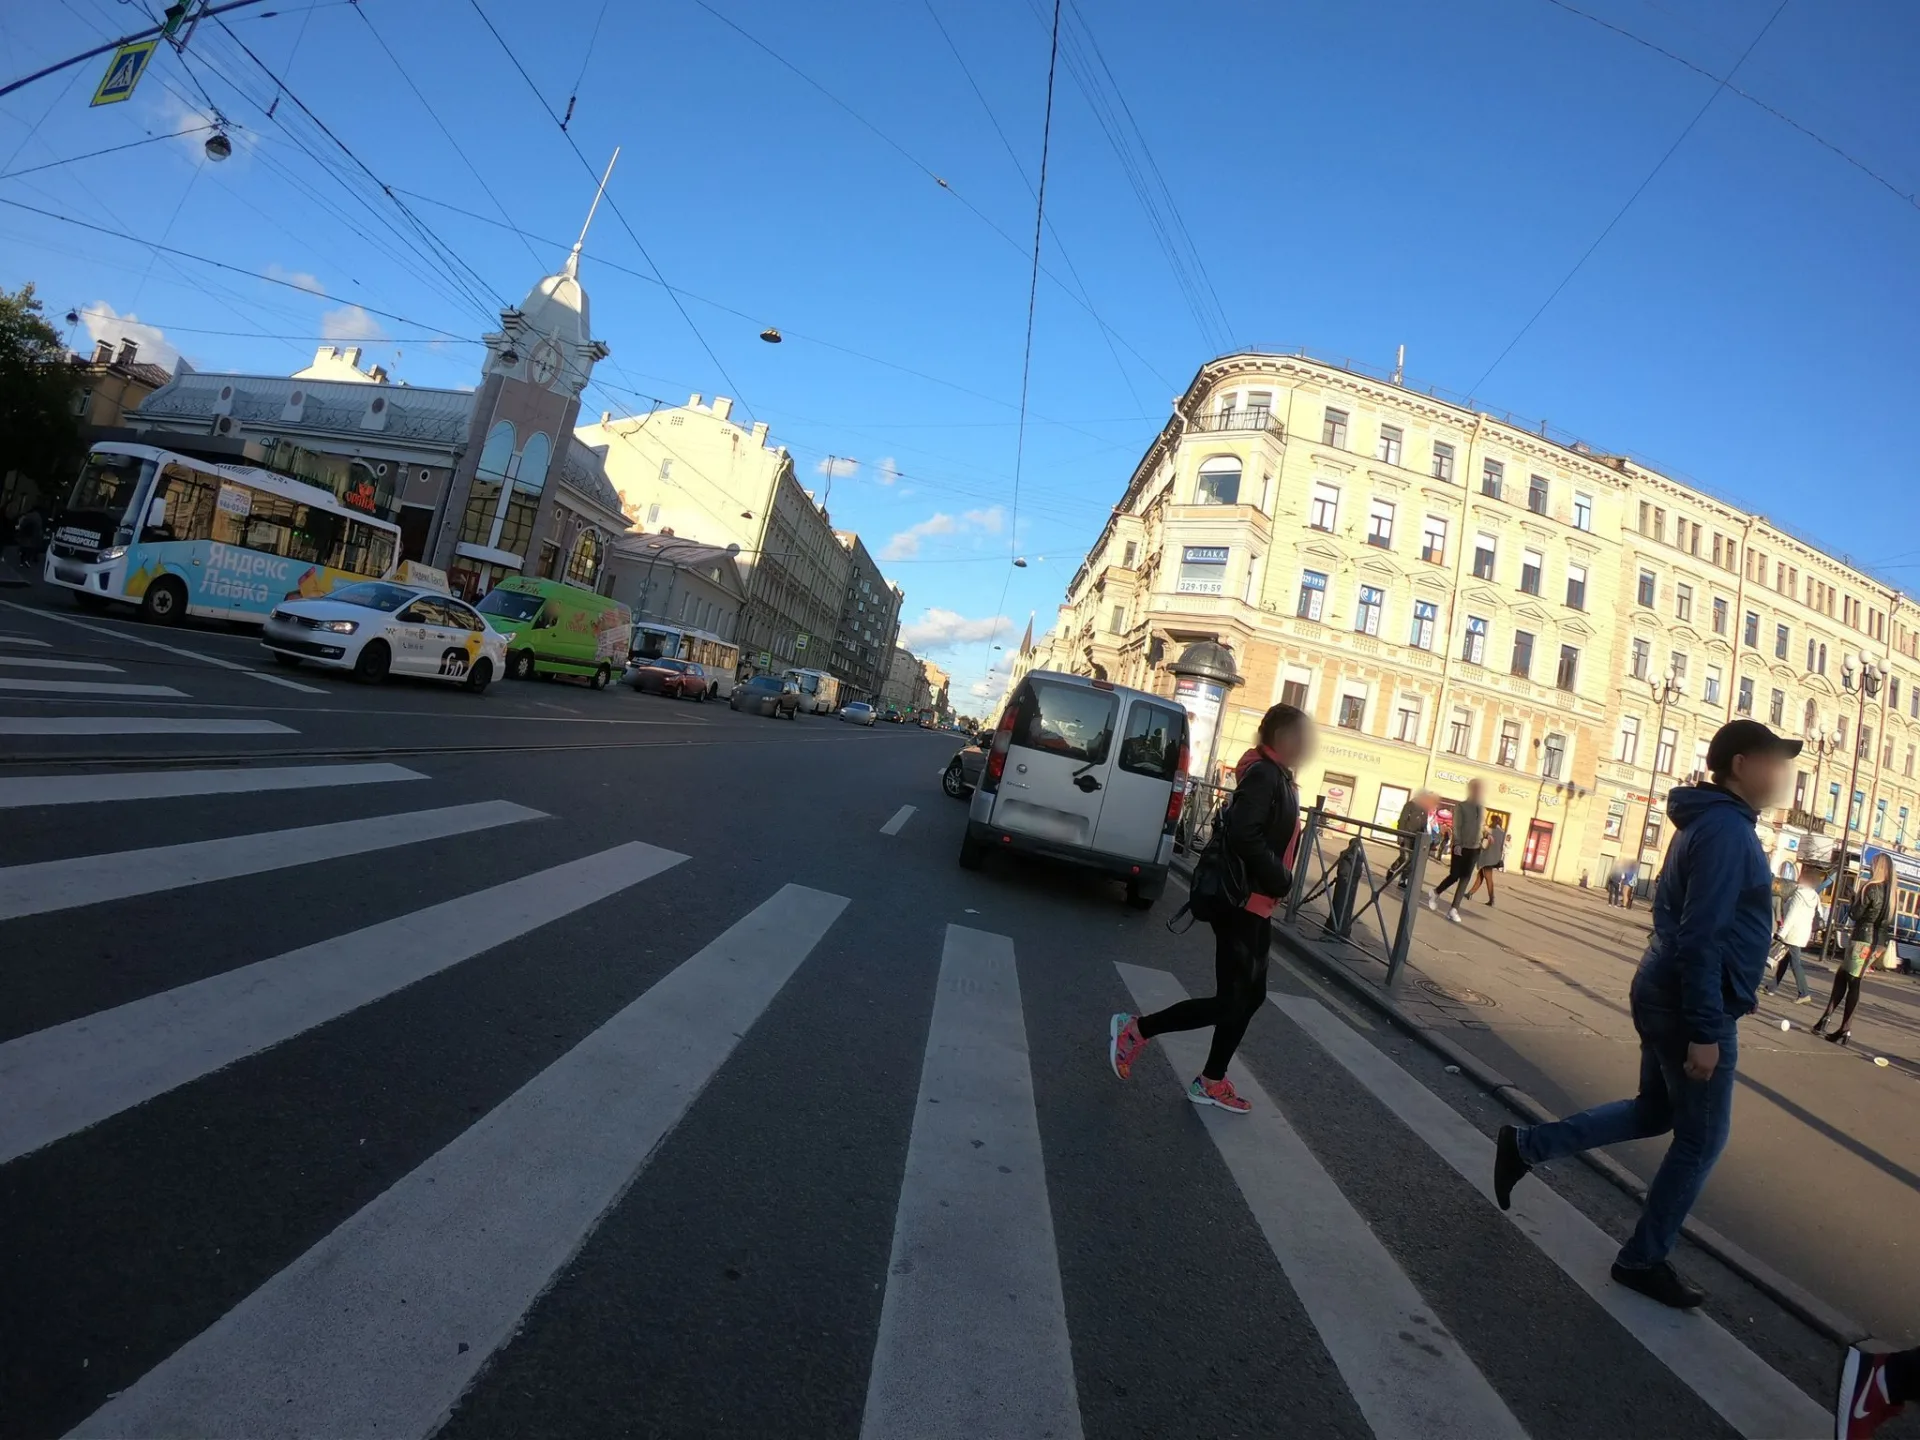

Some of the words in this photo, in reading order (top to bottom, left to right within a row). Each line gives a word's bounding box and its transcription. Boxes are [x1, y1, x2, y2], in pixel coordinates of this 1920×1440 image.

[207, 542, 289, 581] Яндекс
[199, 569, 269, 603] Лавка
[1180, 582, 1222, 592] 329-19-59
[1319, 744, 1381, 764] НДИТЕРСКАЯ
